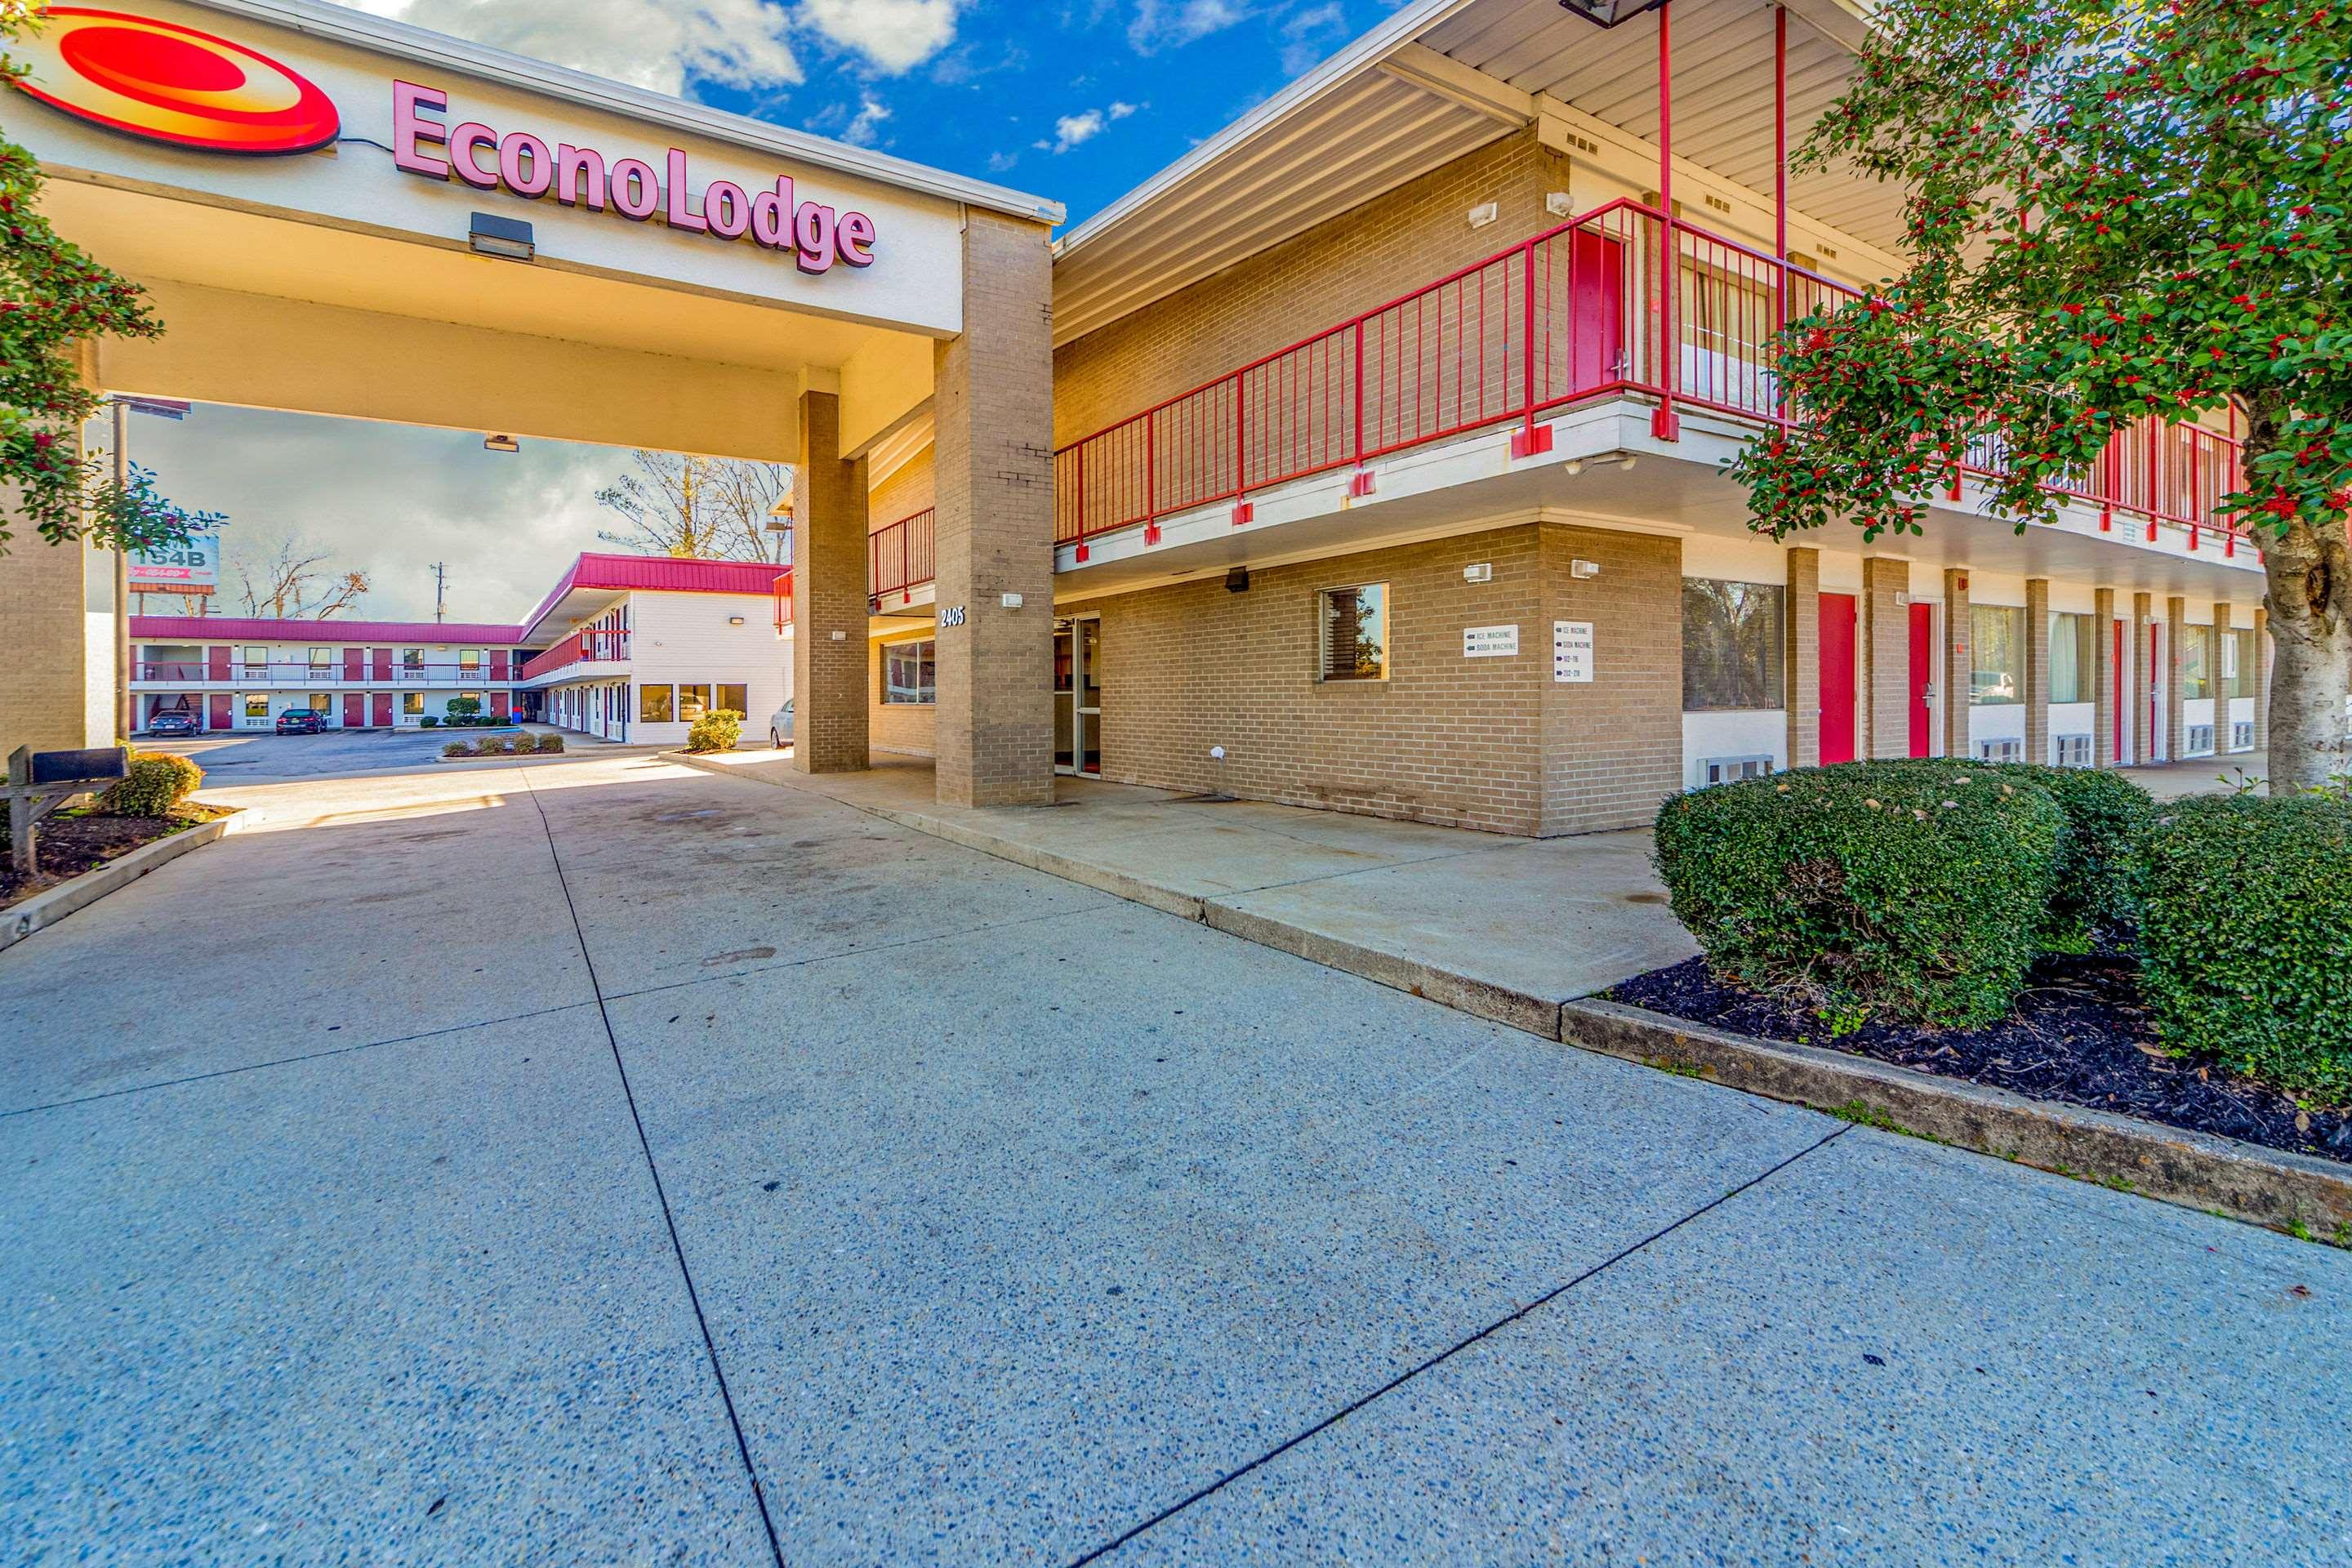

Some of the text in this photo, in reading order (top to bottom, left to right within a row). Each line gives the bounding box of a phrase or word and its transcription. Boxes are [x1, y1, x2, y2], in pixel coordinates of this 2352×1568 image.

[393, 79, 876, 274] EconoLodge
[941, 605, 965, 627] 2405
[1487, 630, 1512, 639] MACHINE
[1477, 642, 1517, 651] SODA MACHINE
